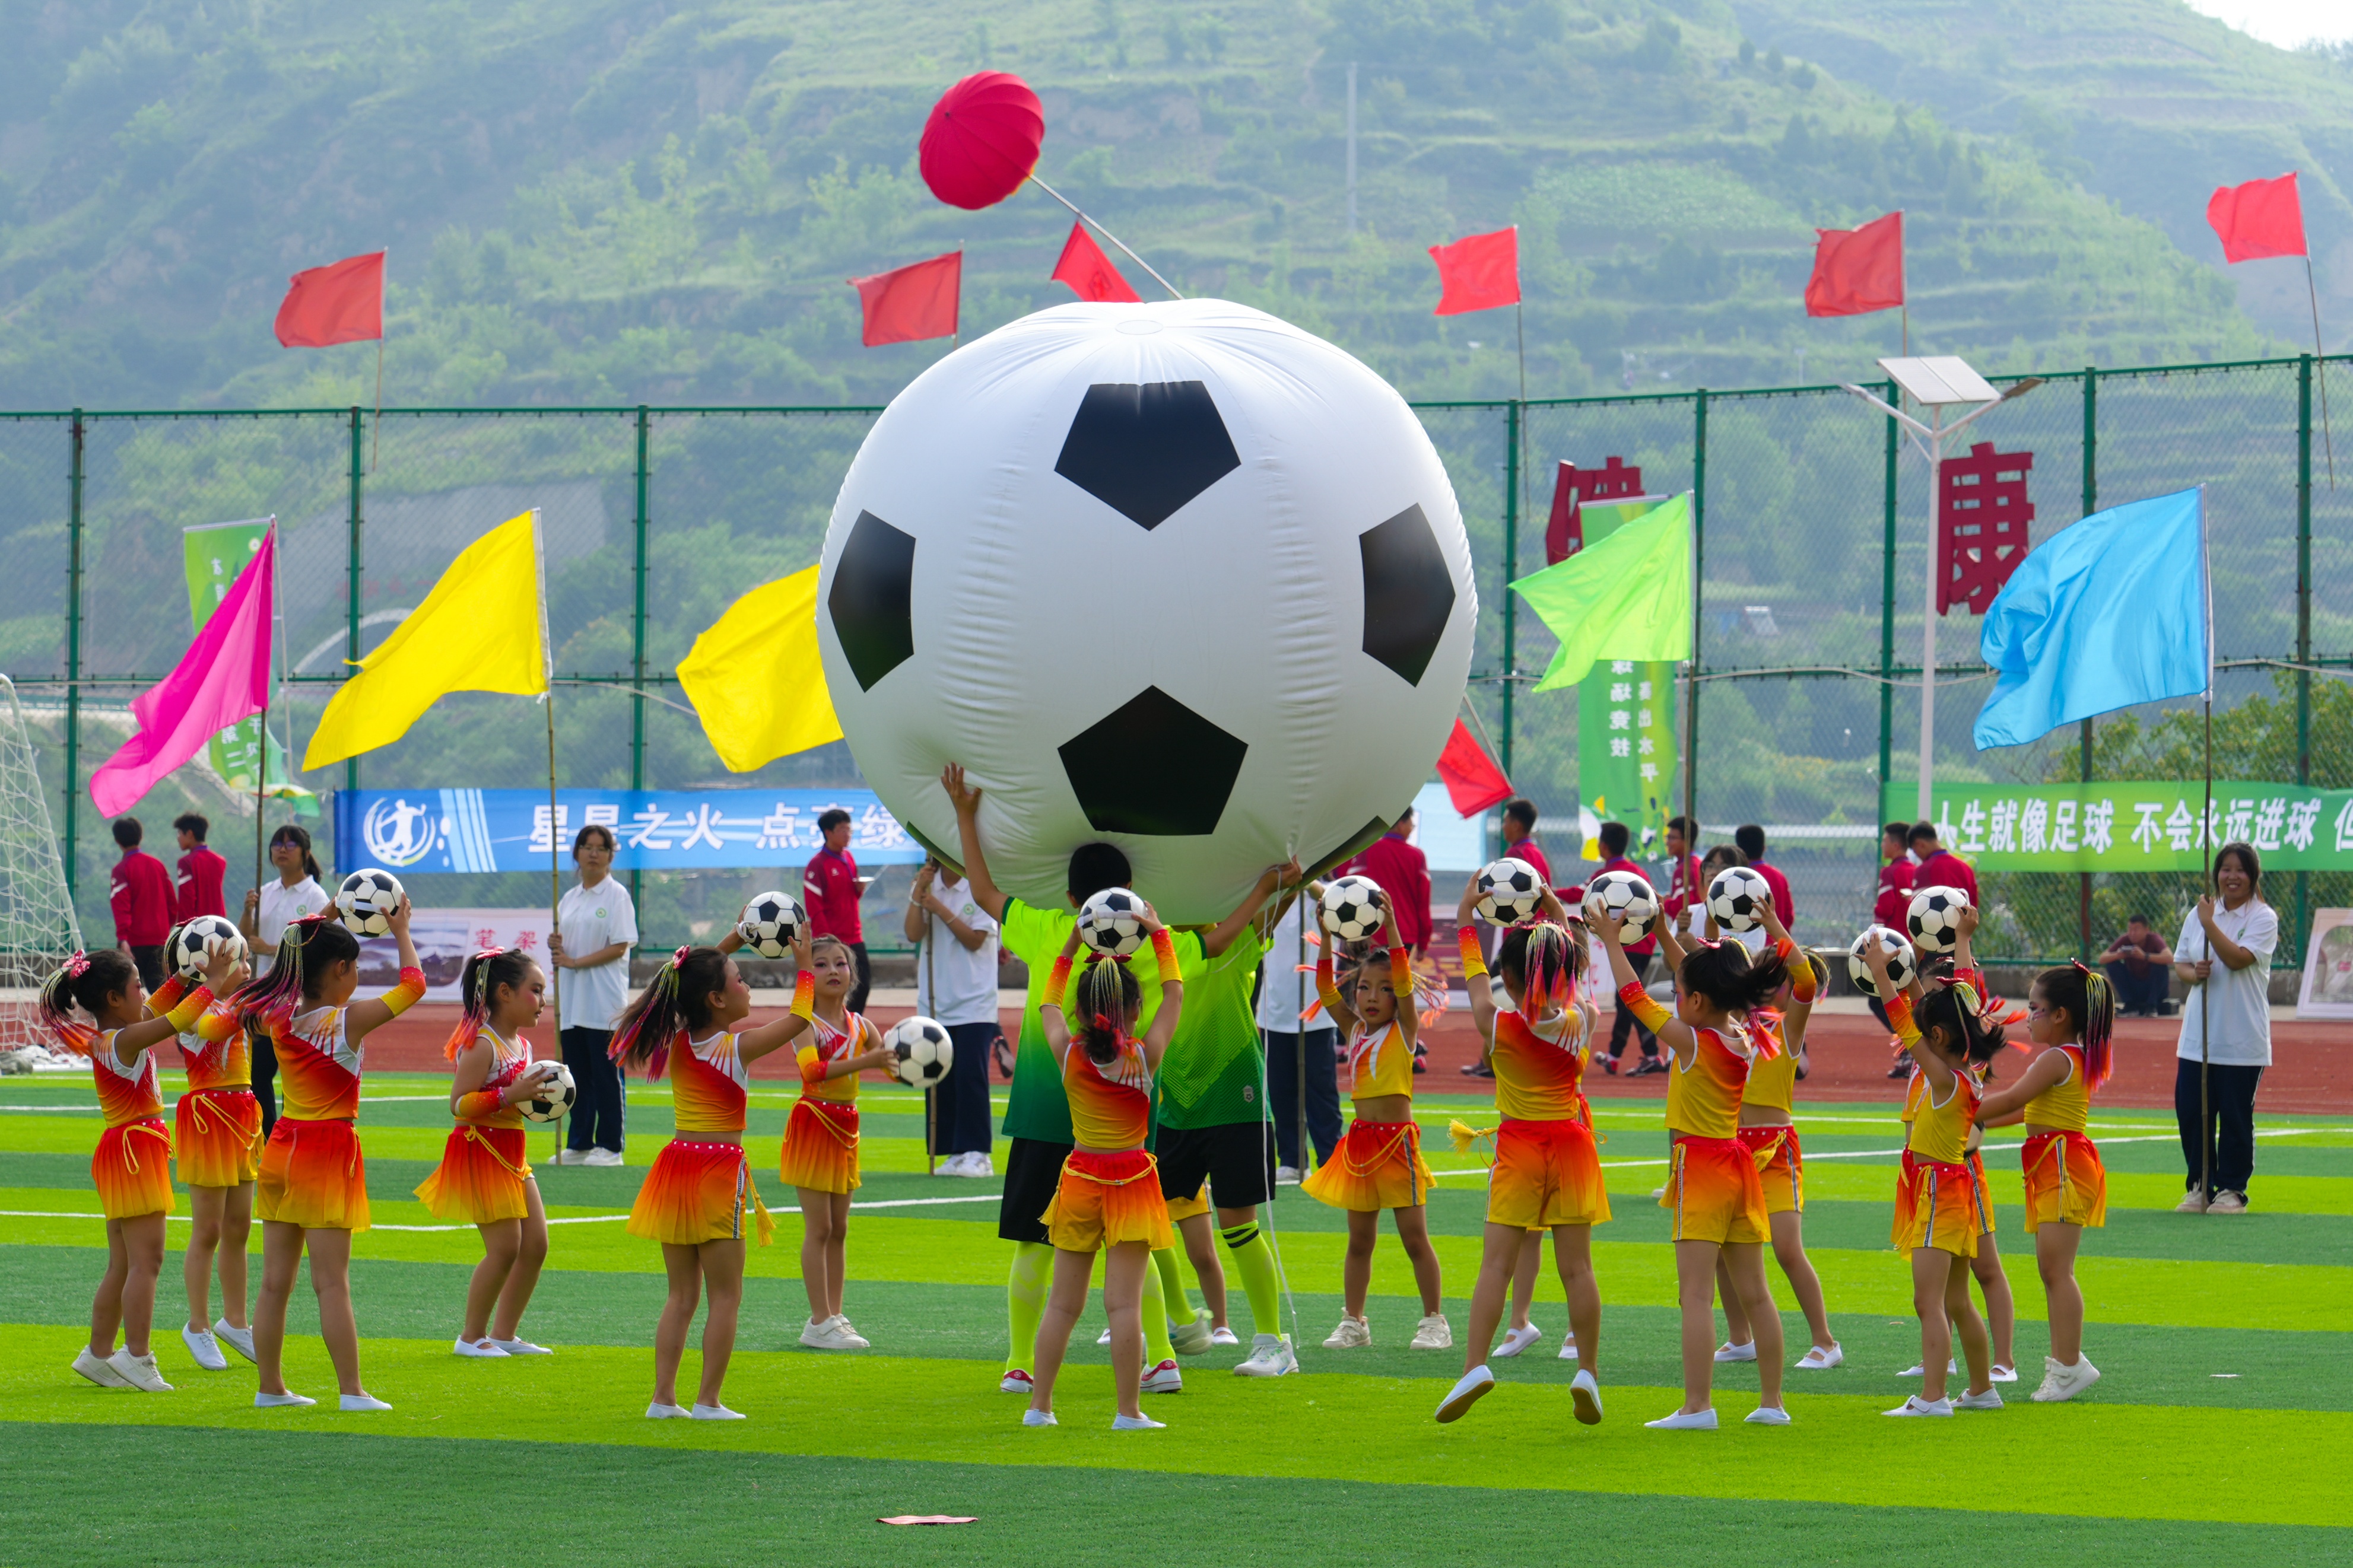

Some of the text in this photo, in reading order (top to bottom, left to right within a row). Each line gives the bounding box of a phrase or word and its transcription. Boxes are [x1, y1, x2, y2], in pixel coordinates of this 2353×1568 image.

[1936, 441, 2035, 616] 康
[1936, 798, 2114, 854] 人生就像足球
[2130, 797, 2322, 854] 不会永远进球
[474, 927, 538, 950] 笔架
